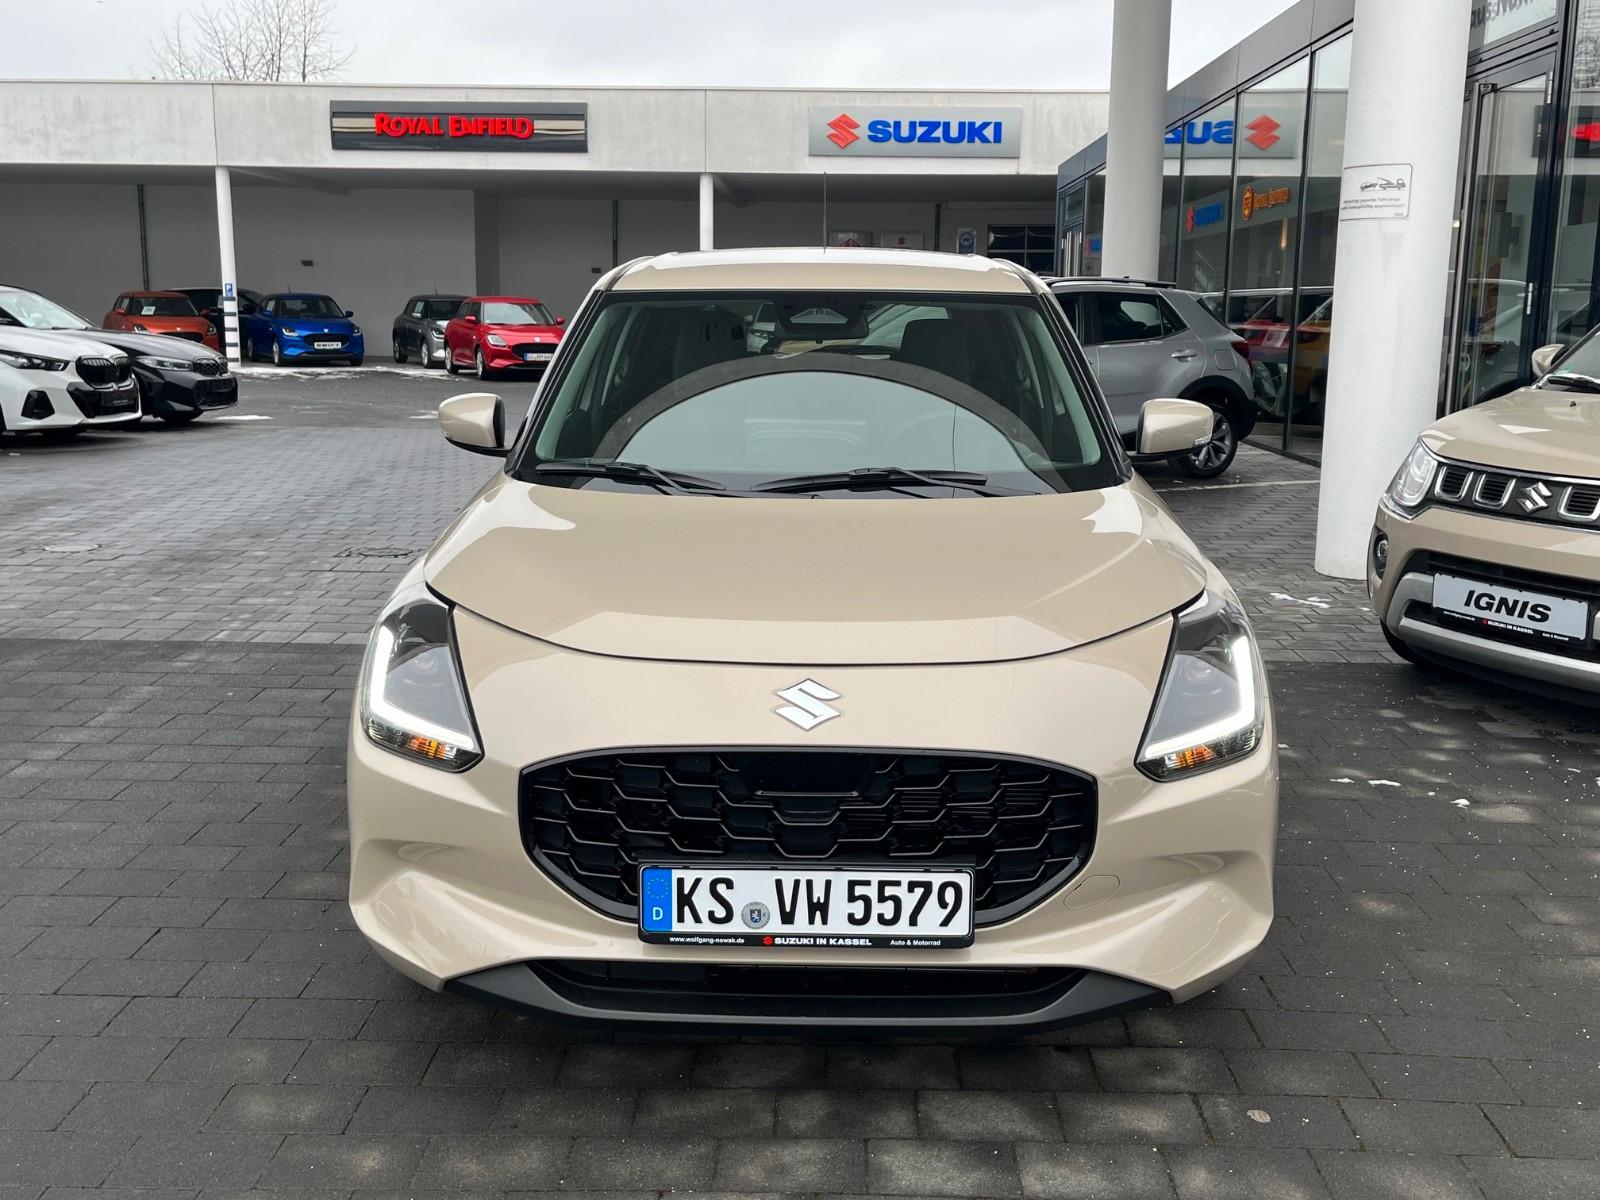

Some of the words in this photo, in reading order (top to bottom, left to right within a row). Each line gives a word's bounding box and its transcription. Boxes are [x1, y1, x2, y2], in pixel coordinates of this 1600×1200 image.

[374, 112, 443, 137] ROYAL
[448, 115, 535, 139] ENFIELD
[867, 119, 1003, 144] SUZUKI
[1464, 589, 1552, 623] IGNIS
[652, 907, 664, 921] D
[676, 877, 735, 925] KS
[774, 878, 832, 926] VW
[847, 879, 963, 927] 5579
[669, 936, 745, 944] www.wolfgang-nowak.de
[774, 937, 814, 945] SUZUKI
[830, 938, 873, 946] KASSEL
